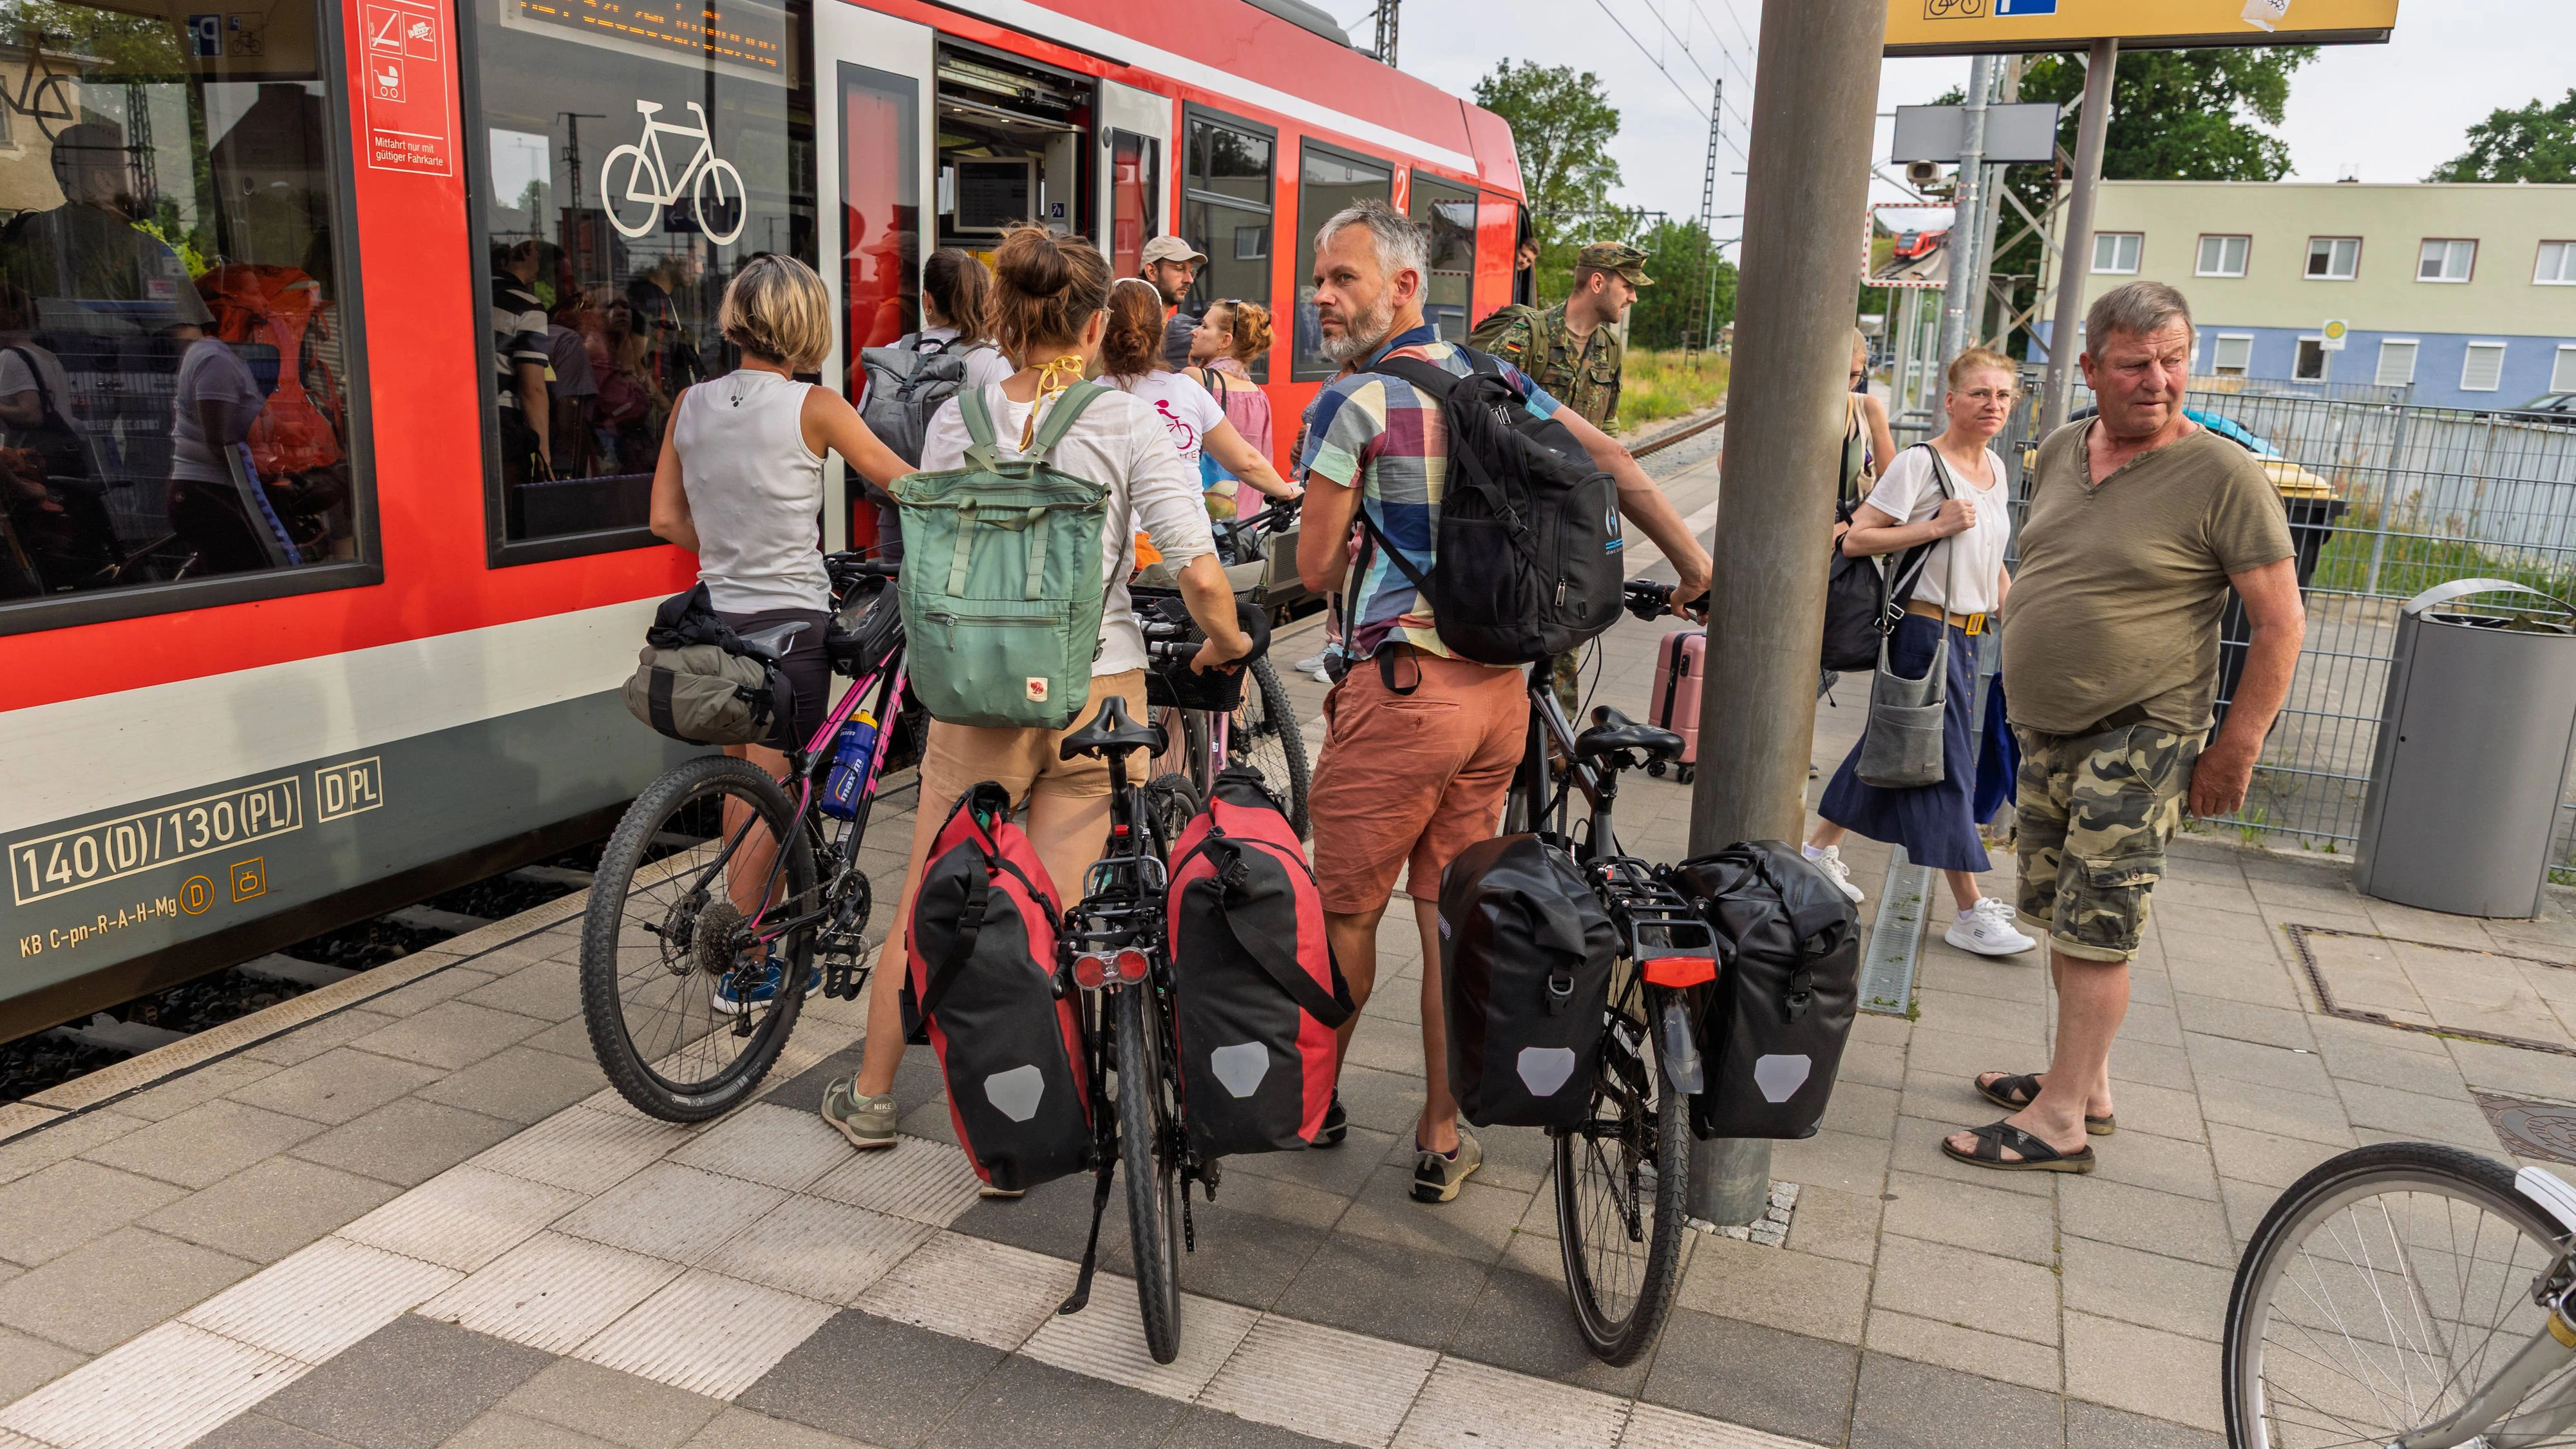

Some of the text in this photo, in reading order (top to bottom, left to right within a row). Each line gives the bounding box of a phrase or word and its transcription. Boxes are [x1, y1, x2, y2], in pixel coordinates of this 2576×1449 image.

[375, 137, 434, 153] Mitfahrt nur mit
[376, 150, 443, 166] gültiger Fahrkarte
[1396, 169, 1406, 214] 2
[863, 667, 907, 800] TREK
[325, 768, 377, 813] D PL
[23, 784, 292, 892] 140(D)/130(PL)
[20, 896, 177, 958] KB C-pn-R-A-H-Mg
